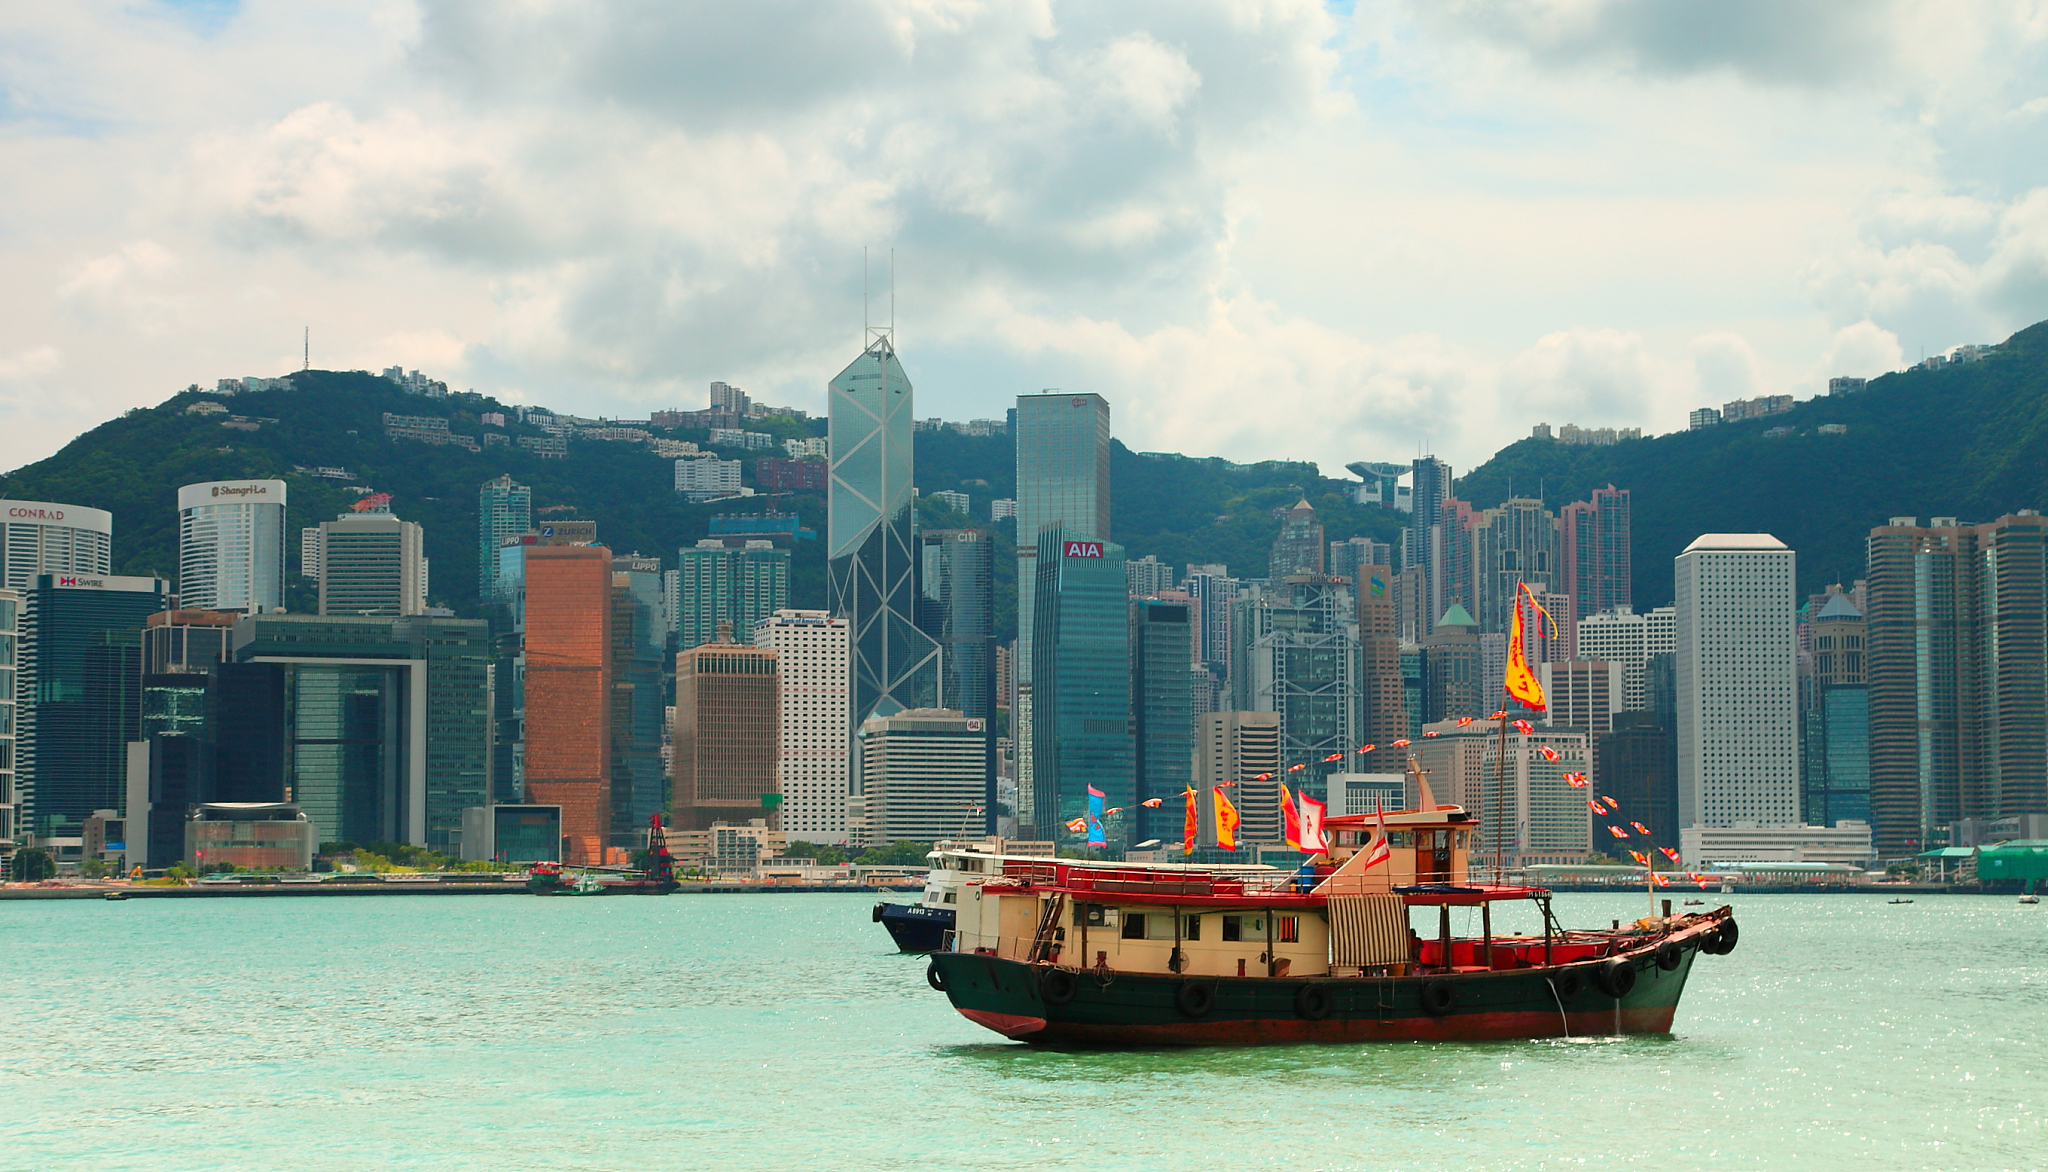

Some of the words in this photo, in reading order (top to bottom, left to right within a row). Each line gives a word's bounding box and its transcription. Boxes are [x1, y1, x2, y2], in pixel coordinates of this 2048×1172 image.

[220, 485, 267, 497] Shangri-La
[9, 507, 65, 520] CONRAD
[557, 527, 592, 536] ZURICH
[500, 536, 520, 546] LIPPO
[1068, 542, 1100, 557] AIA
[631, 561, 657, 572] LIPPO
[801, 617, 824, 625] America
